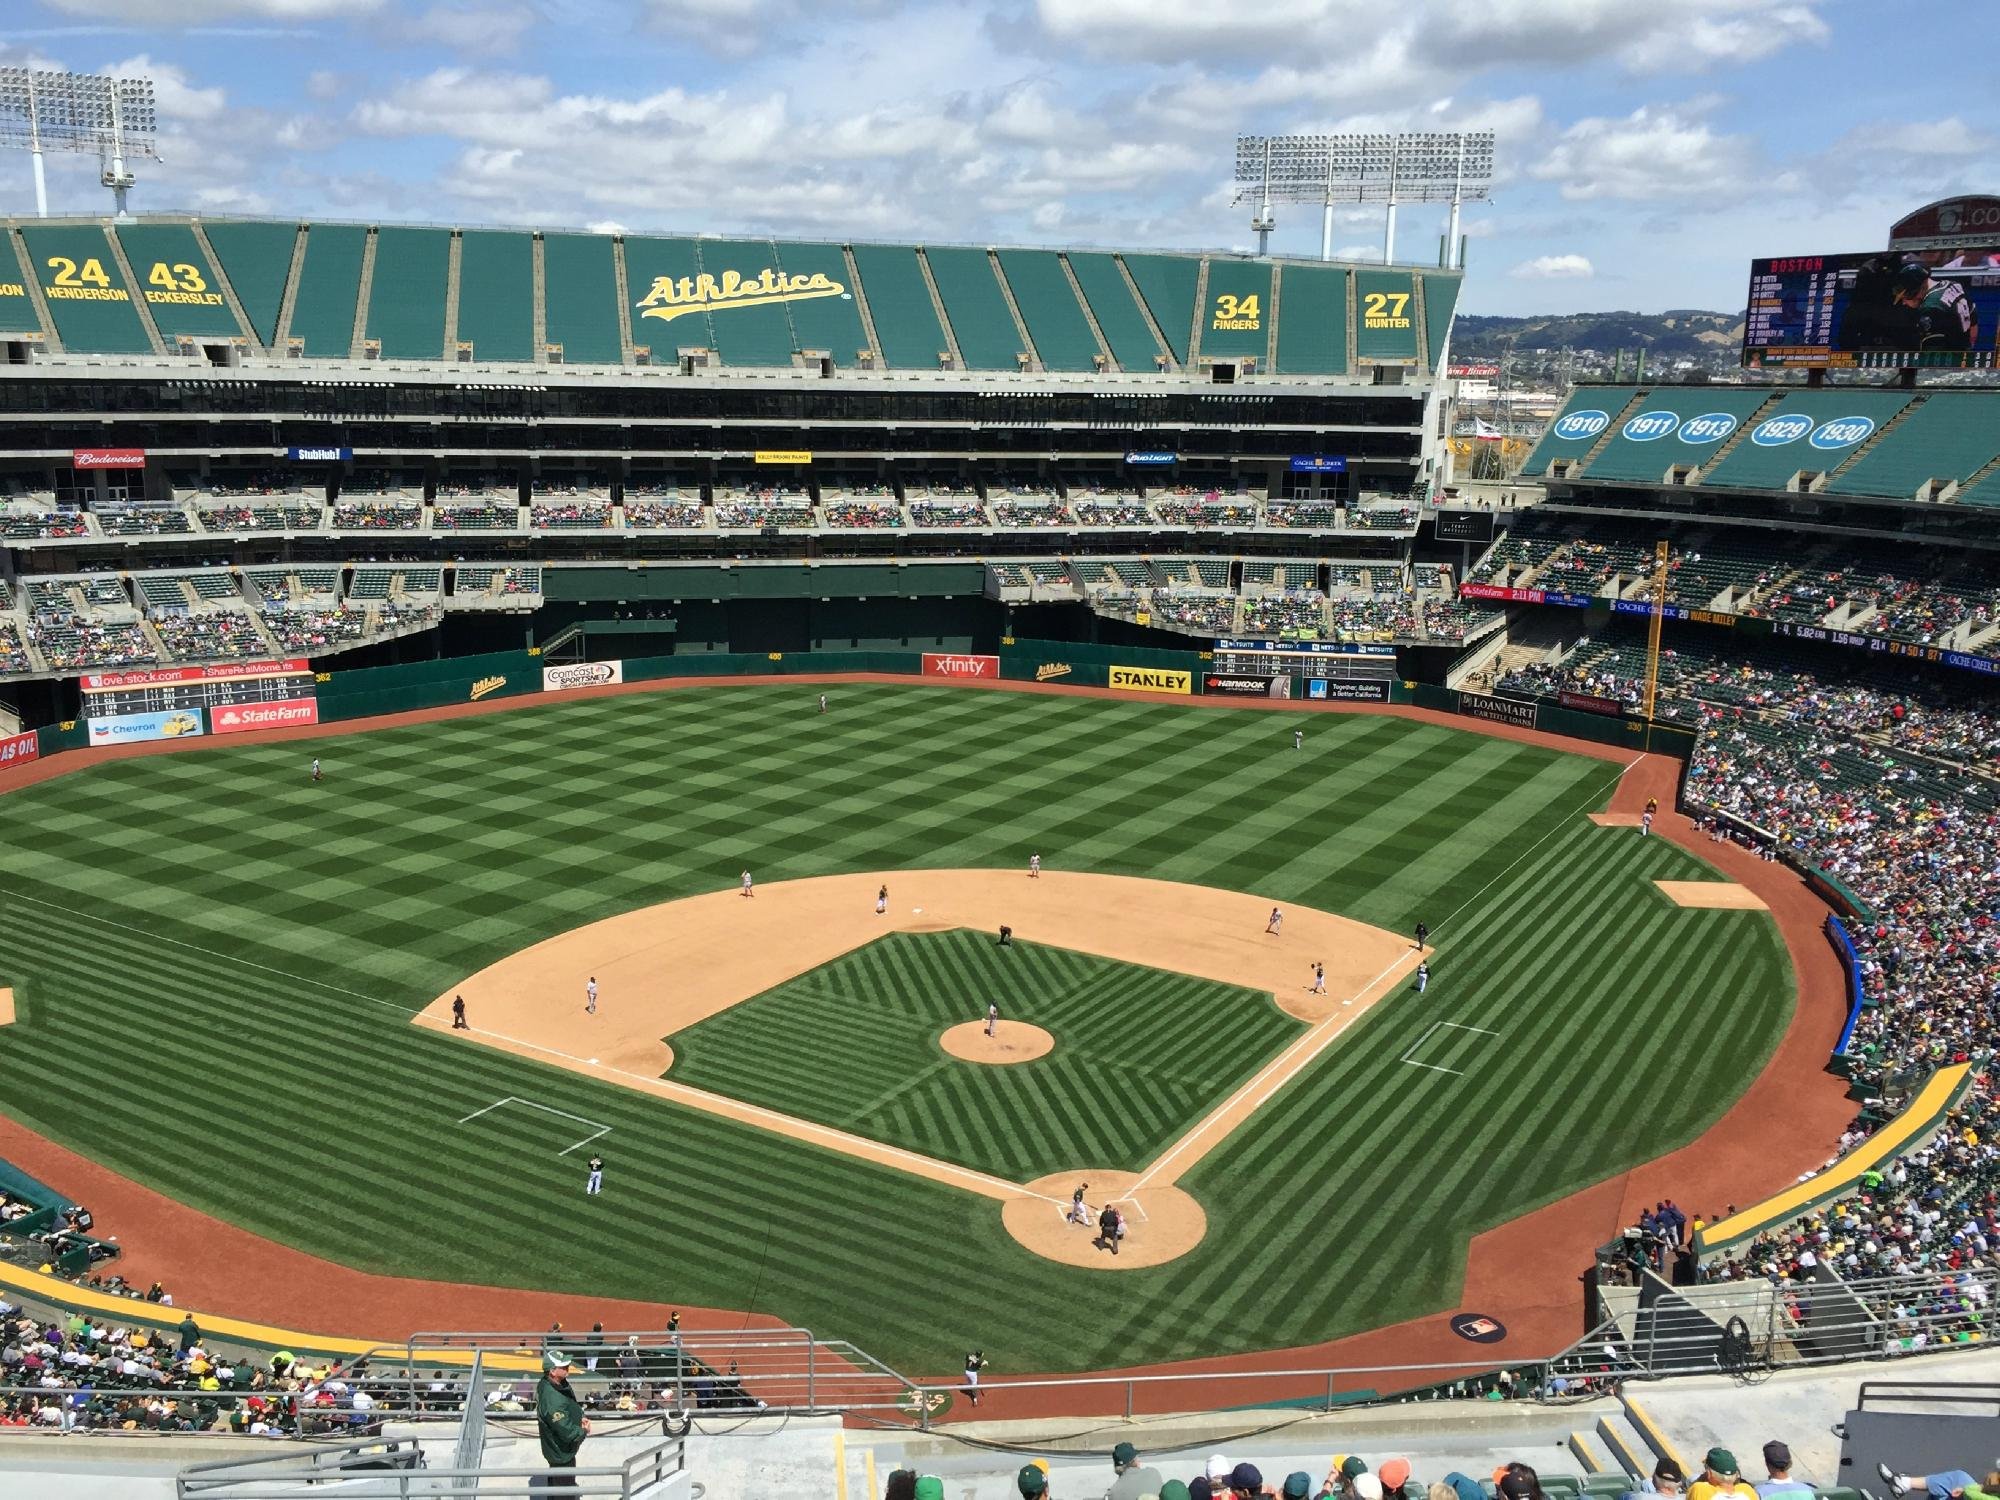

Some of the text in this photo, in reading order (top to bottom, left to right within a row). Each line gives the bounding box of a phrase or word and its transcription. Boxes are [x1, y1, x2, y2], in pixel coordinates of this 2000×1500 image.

[48, 257, 111, 287] 24
[1771, 258, 1823, 272] BOSTON
[149, 262, 207, 292] 43
[46, 287, 129, 301] HENDERSON
[144, 290, 224, 306] ECKERSLEY
[636, 268, 844, 321] Athletics
[1215, 294, 1260, 319] 34
[1364, 293, 1410, 318] 27
[1213, 319, 1260, 330] FINGERS
[1365, 318, 1410, 328] HUNTER
[1561, 416, 1605, 432] 1910
[1629, 418, 1674, 434] 1911
[1685, 419, 1731, 437] 1913
[1759, 421, 1807, 438] 1929
[1818, 423, 1867, 441] 1930
[74, 453, 144, 465] Budweiser
[298, 448, 340, 460] StubHub!
[1512, 590, 1527, 600] 2:11
[1528, 591, 1541, 602] PM
[1617, 602, 1646, 612] CACHE
[1678, 610, 1737, 626] 20 WADE MILEY
[1796, 625, 1814, 639] 5.82
[1814, 630, 1826, 639] ERA
[1832, 631, 1848, 644] 1.56
[769, 652, 782, 660] 400
[1199, 652, 1213, 660] 362
[1870, 639, 1880, 650] 21
[1889, 642, 1899, 653] 37
[1906, 645, 1918, 657] 50
[1927, 648, 1938, 660] 87
[936, 658, 983, 675] xfinity
[1949, 654, 1992, 672] CACHE CREEK
[315, 673, 331, 682] 362
[560, 674, 606, 684] SPORTSNET
[1036, 662, 1072, 681] Athletics
[470, 675, 507, 700] Athletics
[1113, 671, 1186, 689] STANLEY
[1404, 681, 1418, 689] 367
[1473, 709, 1532, 727] CAR TITLE LOANS
[112, 723, 156, 734] Chevron
[19, 737, 35, 756] OIL
